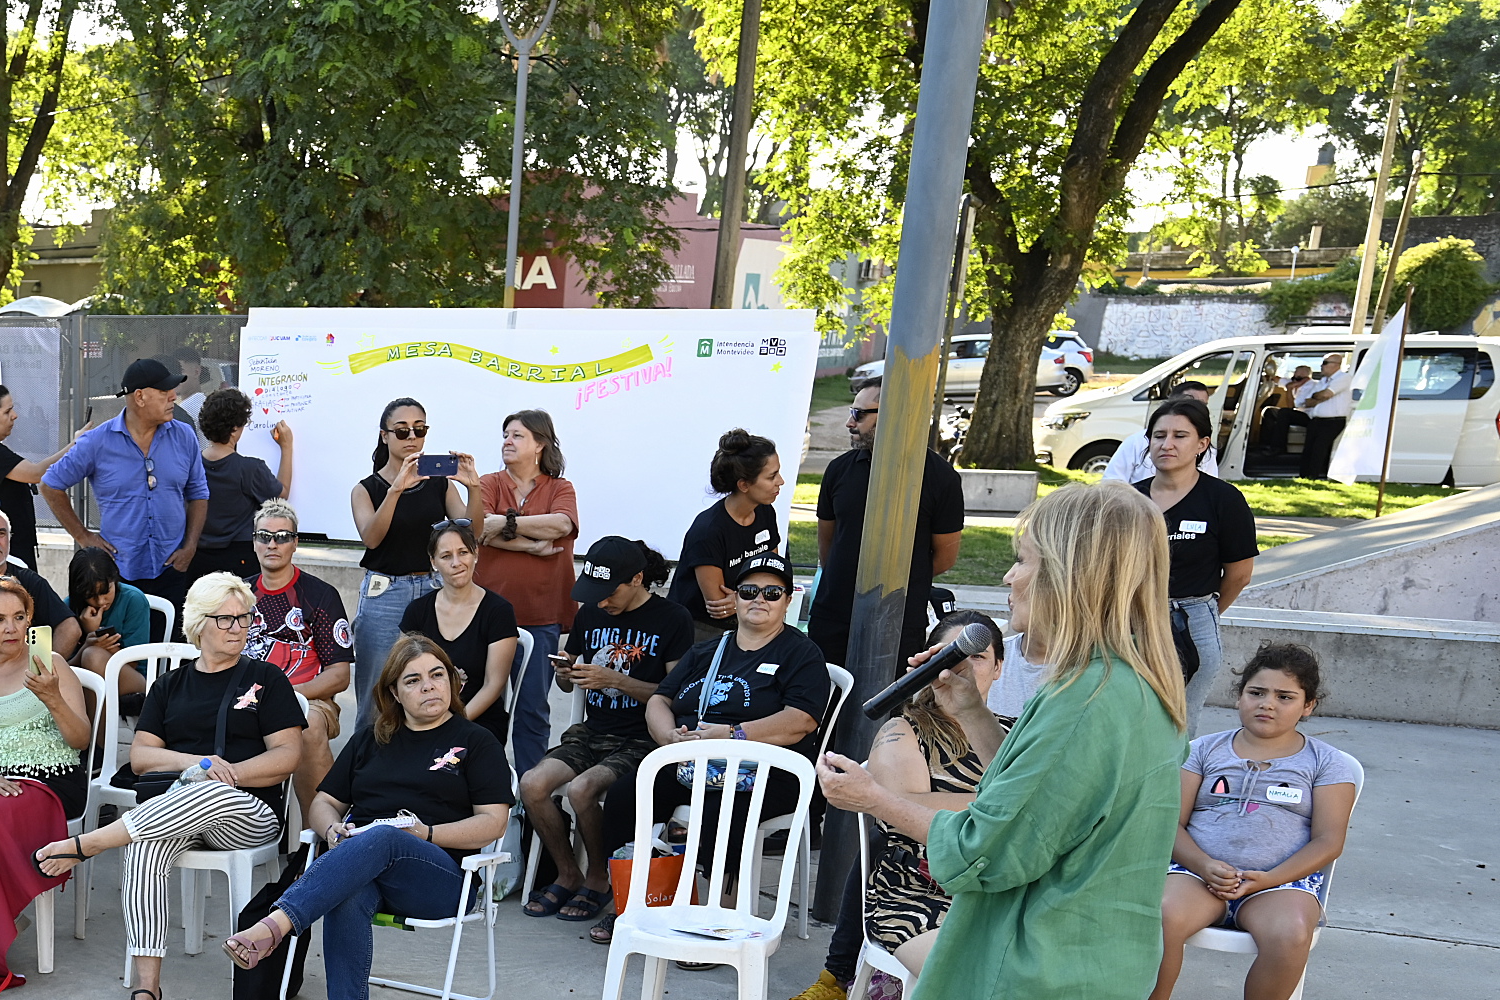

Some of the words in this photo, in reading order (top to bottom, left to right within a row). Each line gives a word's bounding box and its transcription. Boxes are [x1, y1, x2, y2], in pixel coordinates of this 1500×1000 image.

[258, 371, 308, 387] INTEGRACIÓN
[386, 342, 453, 361] MESA
[469, 350, 612, 382] BARRIAL
[574, 356, 673, 411] ¡FESTIVA!
